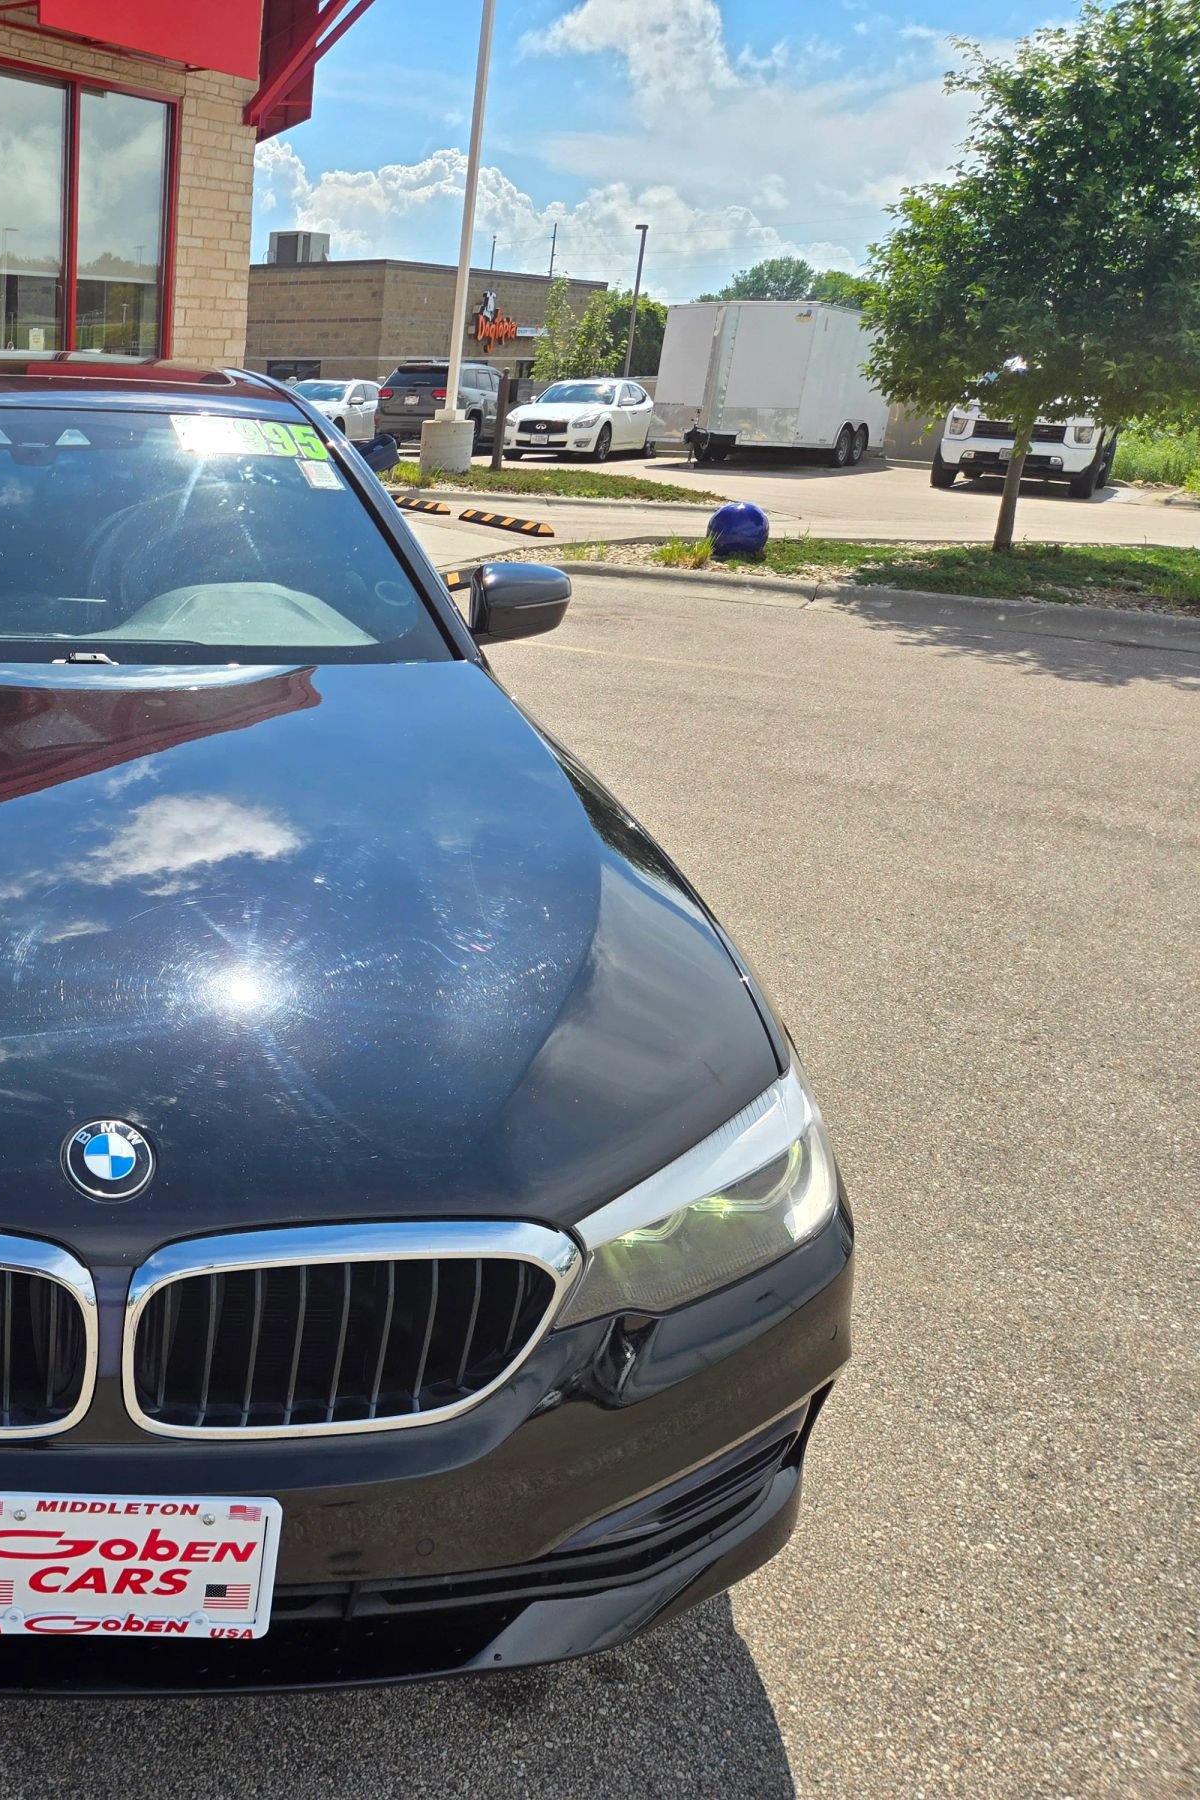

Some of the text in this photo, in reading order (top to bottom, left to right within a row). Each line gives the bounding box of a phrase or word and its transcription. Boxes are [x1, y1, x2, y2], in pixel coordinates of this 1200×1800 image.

[76, 1122, 143, 1145] BMW
[35, 1500, 200, 1516] MIDDLETON
[28, 1566, 192, 1596] CARS
[209, 1628, 253, 1639] USA
